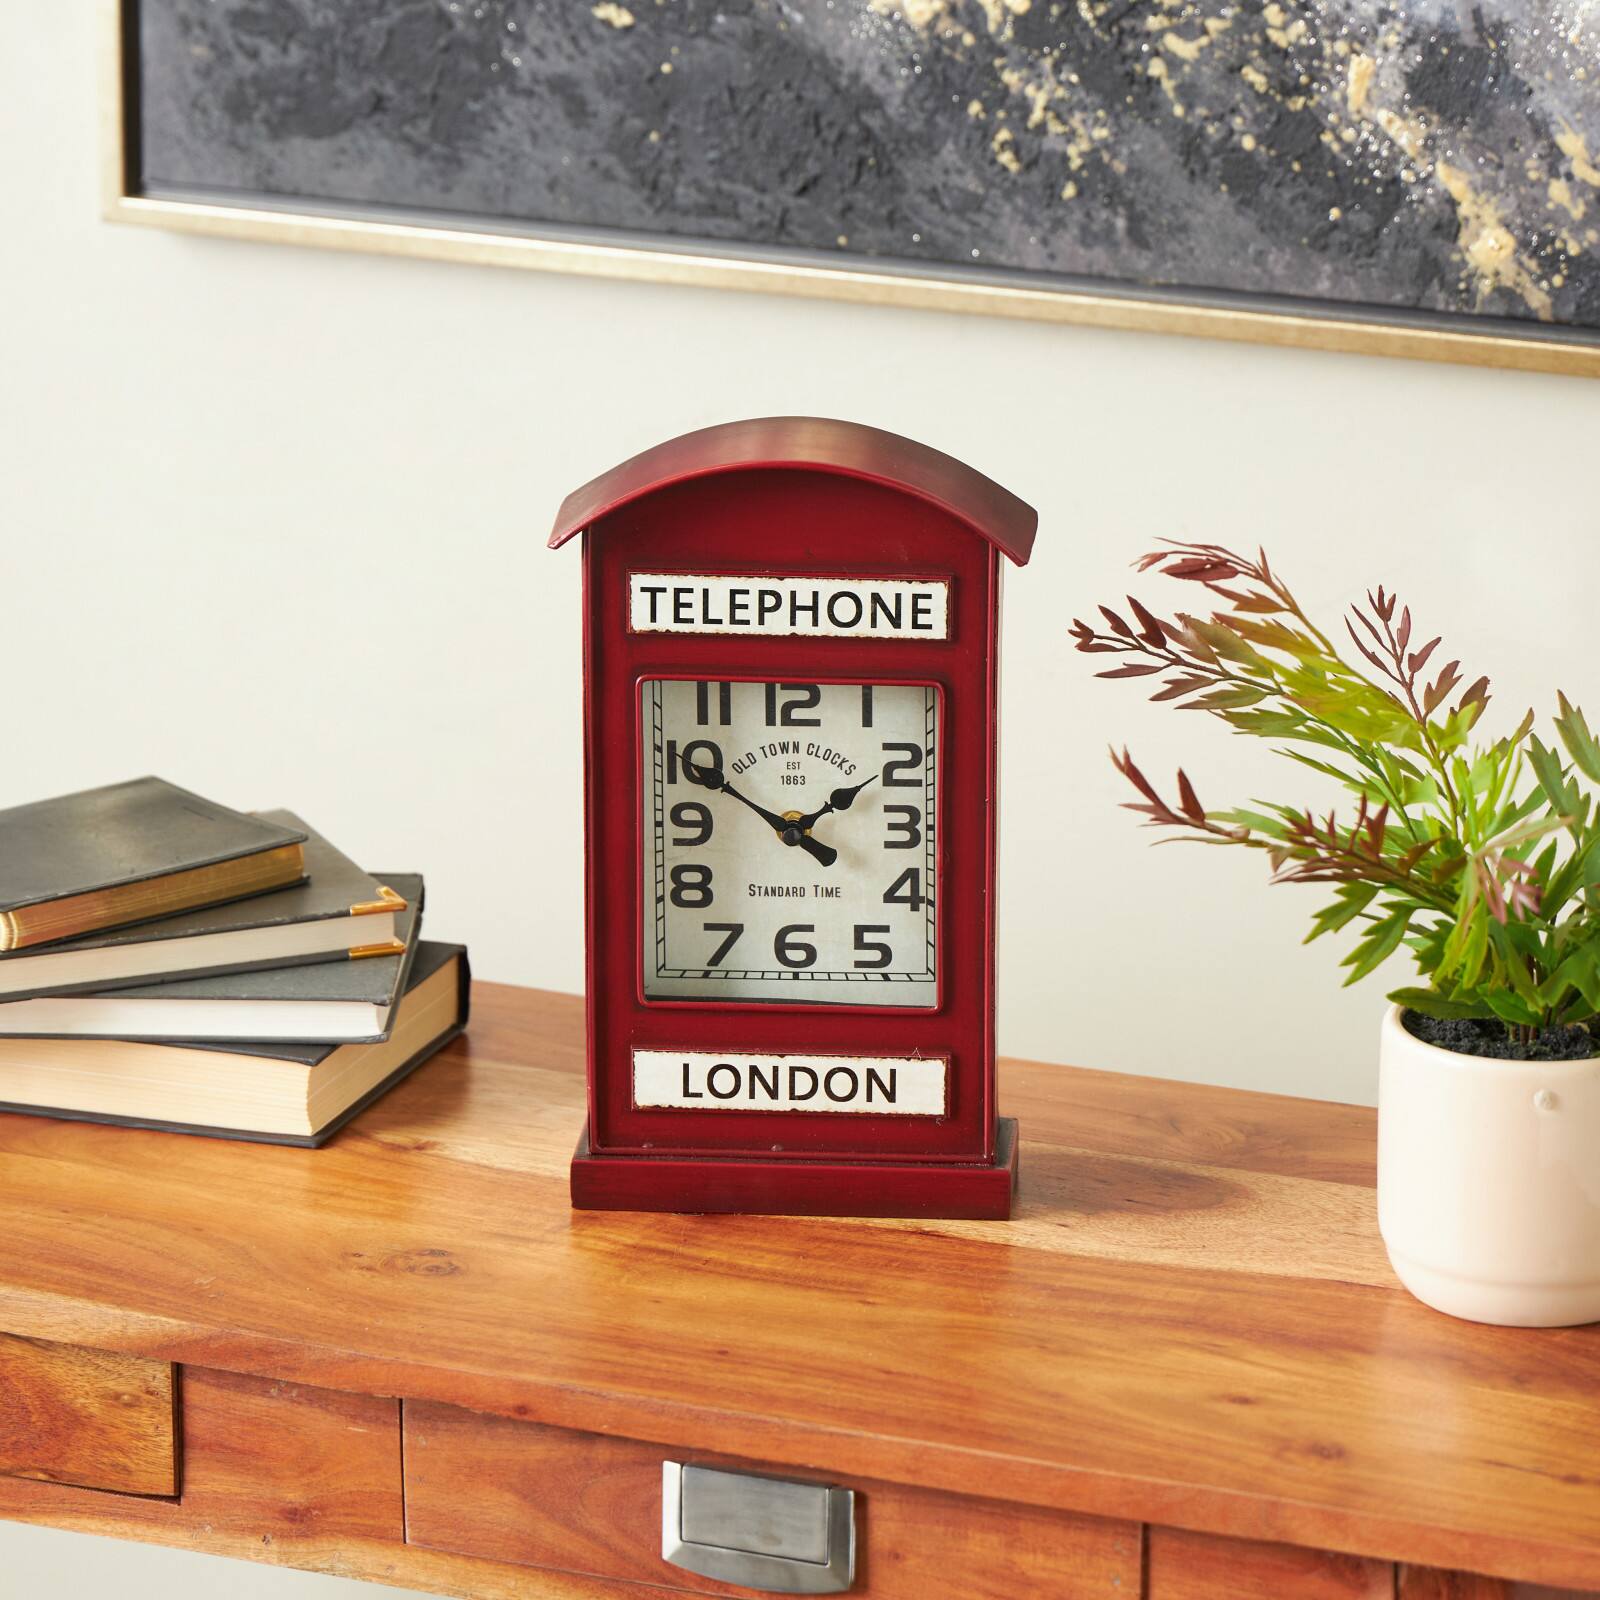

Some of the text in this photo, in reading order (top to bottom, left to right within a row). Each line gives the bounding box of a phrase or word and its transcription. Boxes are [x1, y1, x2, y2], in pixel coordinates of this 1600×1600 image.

[640, 586, 933, 630] TELEPHONE
[696, 681, 732, 726] 11
[764, 683, 822, 727] 12
[861, 685, 873, 728] 1
[666, 739, 724, 785] 10
[731, 741, 857, 776] OLD TOWN CLOCKS
[780, 775, 806, 785] 1863
[786, 761, 801, 770] EST
[881, 742, 923, 787] 2
[669, 801, 714, 847] 9
[883, 804, 922, 849] 3
[669, 864, 714, 909] 8
[748, 883, 841, 899] STANDARD TIME
[882, 867, 926, 912] 4
[703, 922, 744, 967] 7
[773, 924, 818, 969] 6
[853, 924, 893, 969] 5
[682, 1063, 897, 1103] LONDON
